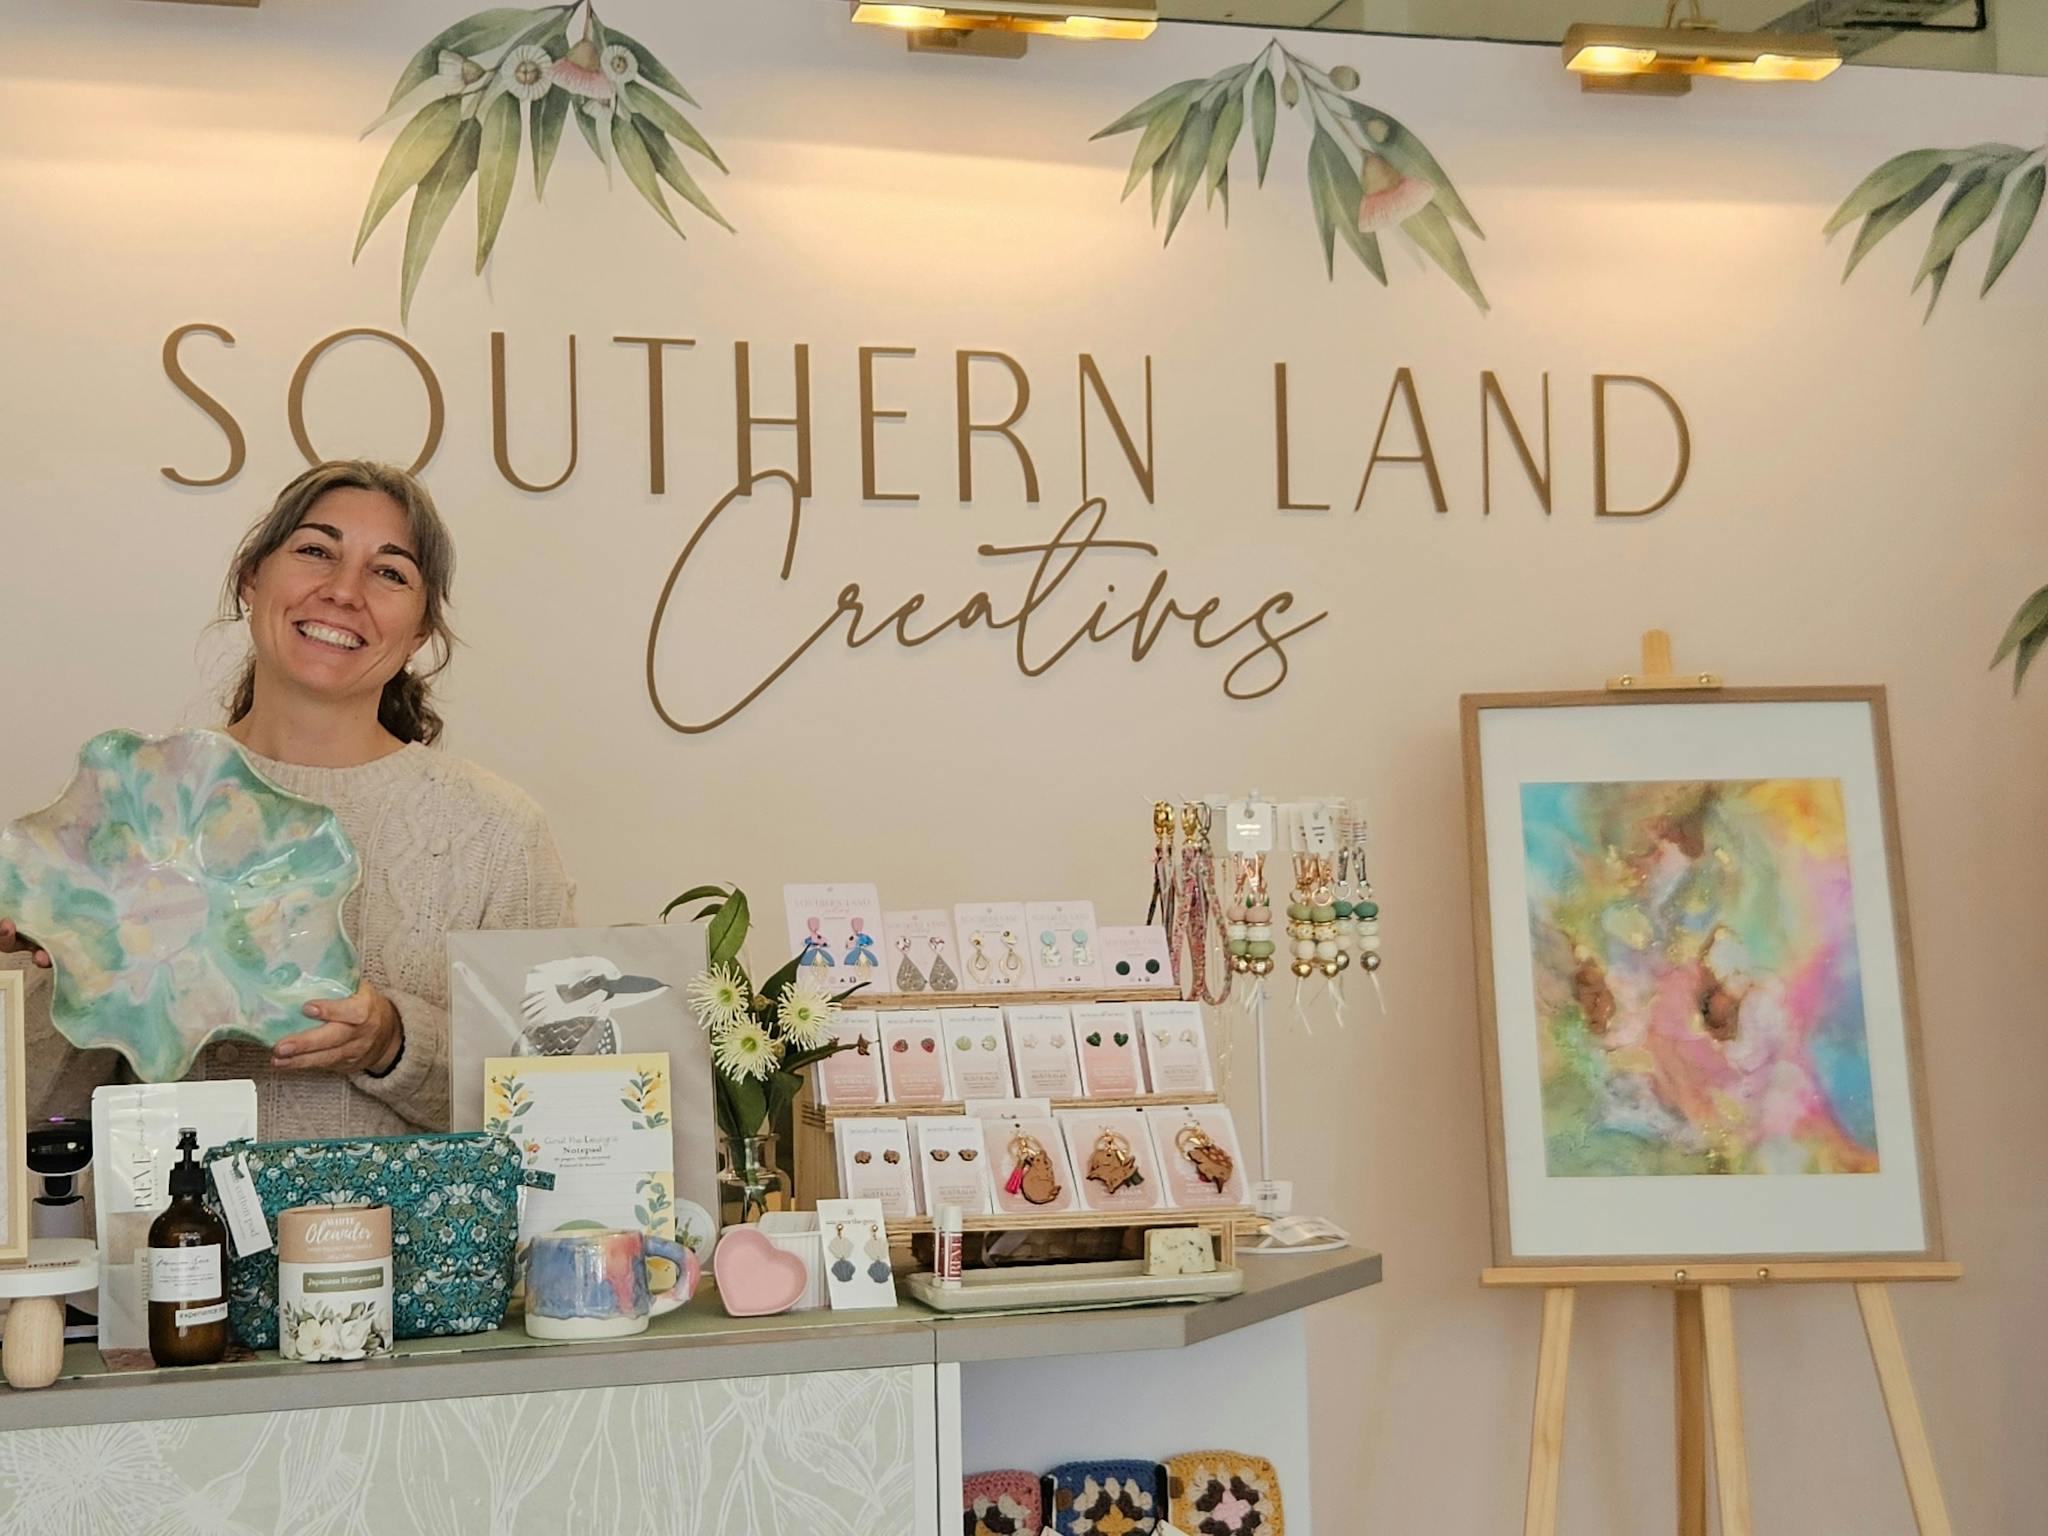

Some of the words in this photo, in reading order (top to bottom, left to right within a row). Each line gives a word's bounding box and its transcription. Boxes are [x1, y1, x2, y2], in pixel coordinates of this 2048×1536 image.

[160, 323, 1154, 504] SOUTHERN
[1275, 362, 1691, 517] LAND
[647, 469, 1329, 734] Creatives
[563, 1146, 603, 1155] Notepad
[233, 1185, 252, 1218] cotton
[305, 1221, 373, 1244] Oleander
